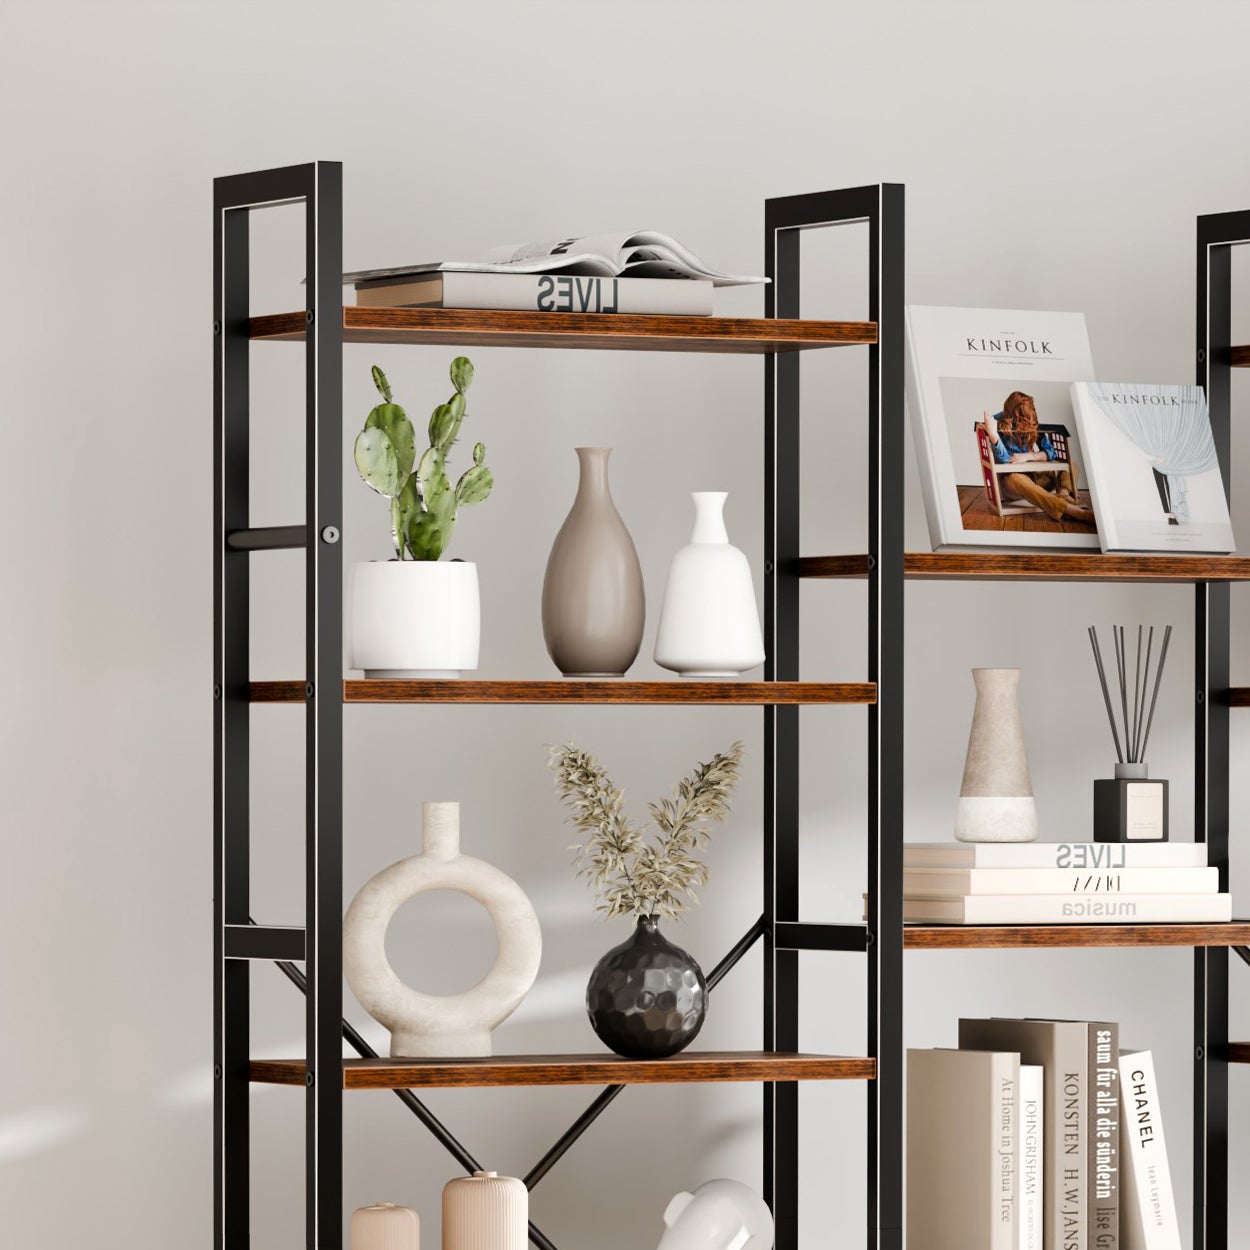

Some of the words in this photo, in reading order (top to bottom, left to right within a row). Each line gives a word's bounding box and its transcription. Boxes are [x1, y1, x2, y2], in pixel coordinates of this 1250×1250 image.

[967, 338, 1052, 354] KINFOLK
[1112, 394, 1179, 406] KINFOLK
[1097, 1031, 1111, 1063] saum
[1001, 1078, 1013, 1090] At
[1097, 1068, 1118, 1087] für
[1001, 1097, 1013, 1131] Home
[1064, 1073, 1079, 1155] KONSTEN
[1097, 1091, 1117, 1115] alla
[1131, 1070, 1154, 1149] CHANEL
[1001, 1136, 1013, 1146] in
[1097, 1119, 1117, 1139] die
[999, 1150, 1014, 1192] Joshua
[1096, 1142, 1117, 1199] sünderin
[1001, 1196, 1013, 1222] Tree
[1096, 1207, 1116, 1229] lise
